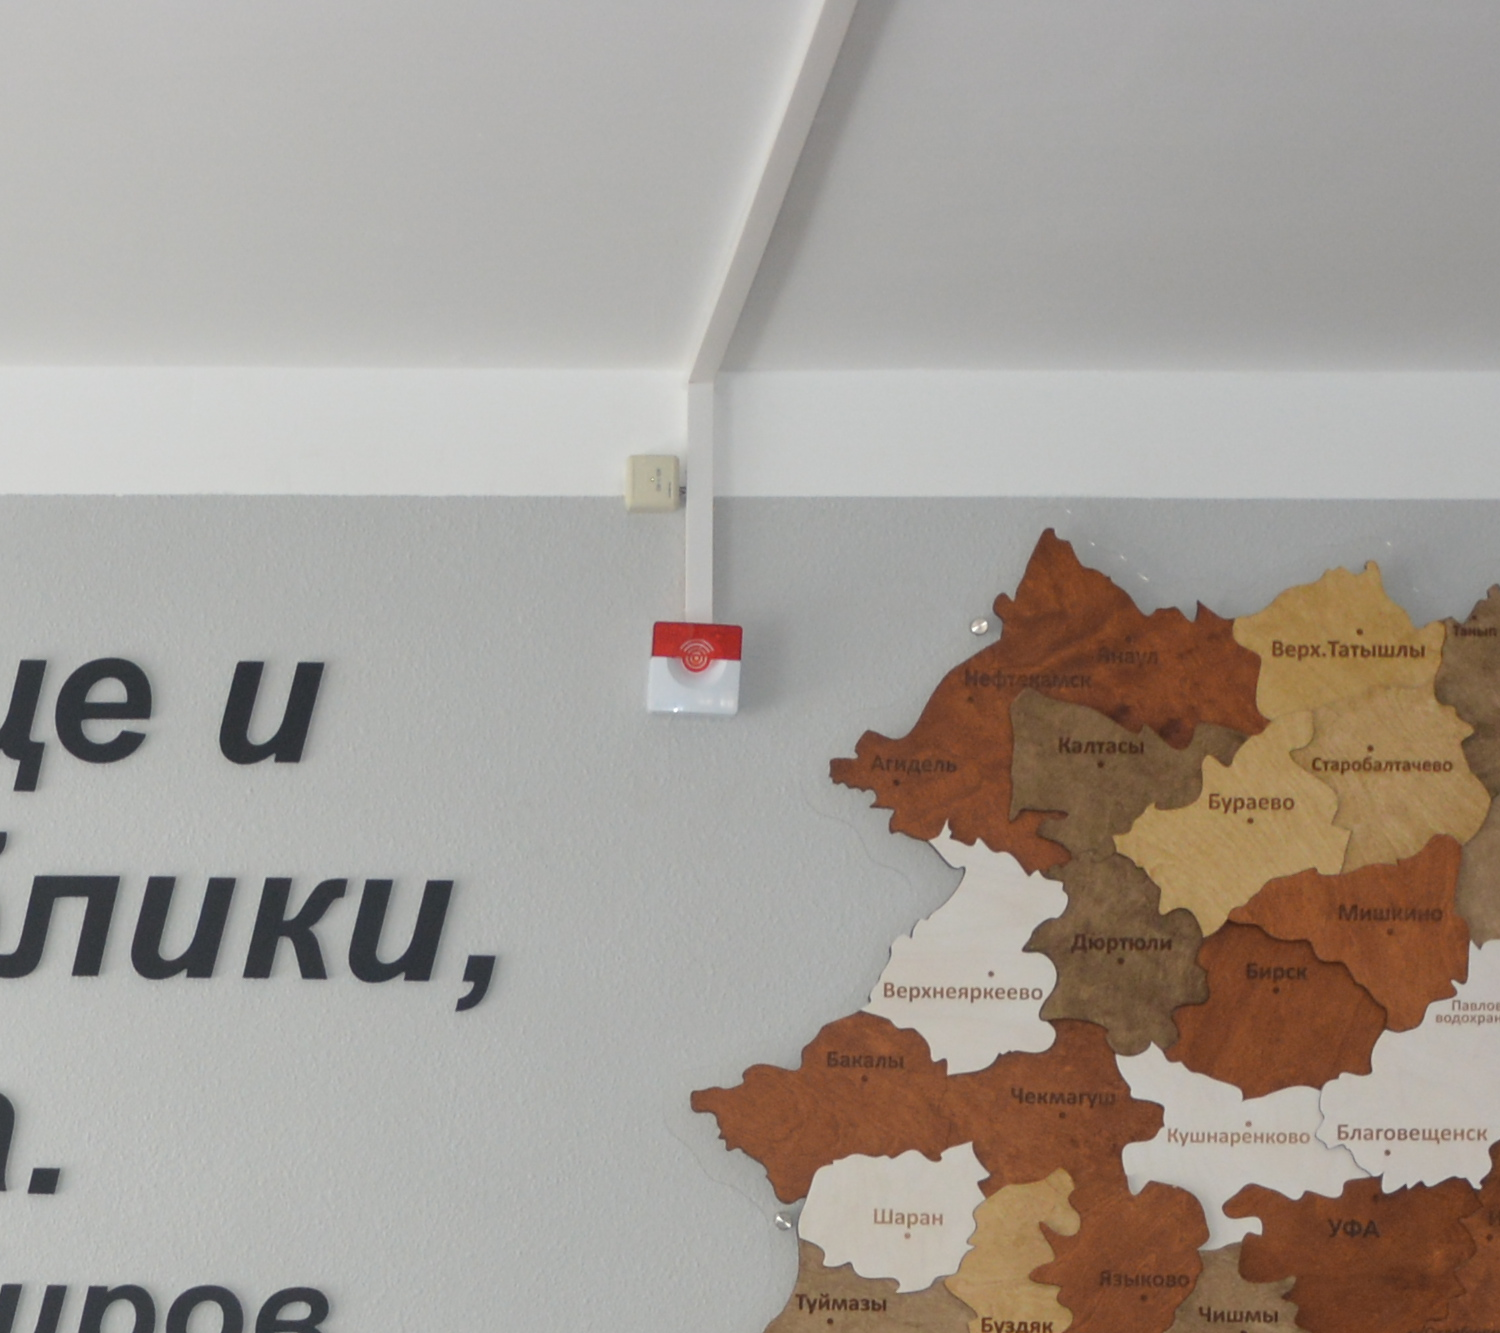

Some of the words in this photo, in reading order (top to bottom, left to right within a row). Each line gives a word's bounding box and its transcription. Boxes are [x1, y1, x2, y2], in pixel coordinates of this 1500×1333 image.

[1098, 649, 1158, 667] Янаул
[1272, 640, 1425, 659] Верх.Татышлы
[964, 670, 1092, 689] Нефтекамск
[220, 660, 324, 765] и
[1059, 738, 1144, 754] Калтасы
[870, 755, 957, 775] Агидель
[1312, 758, 1453, 775] Старобалтачево
[1209, 794, 1295, 812] Бураево
[1338, 905, 1443, 922] Мишкино
[1072, 934, 1172, 954] Дюртюли
[1246, 963, 1307, 982] Бирск
[884, 982, 1043, 1002] Верхнеяркеево
[827, 1052, 904, 1069] Бакалы
[1010, 1085, 1117, 1108] Чекмагуш
[1167, 1128, 1310, 1147] Кушнаренково
[1337, 1124, 1488, 1143] Благовещенск
[873, 1209, 943, 1228] Шаран
[1327, 1218, 1380, 1240] УФА
[1101, 1272, 1190, 1288] Языково
[796, 1294, 887, 1315] Туймазы
[1199, 1306, 1279, 1324] Чишмы
